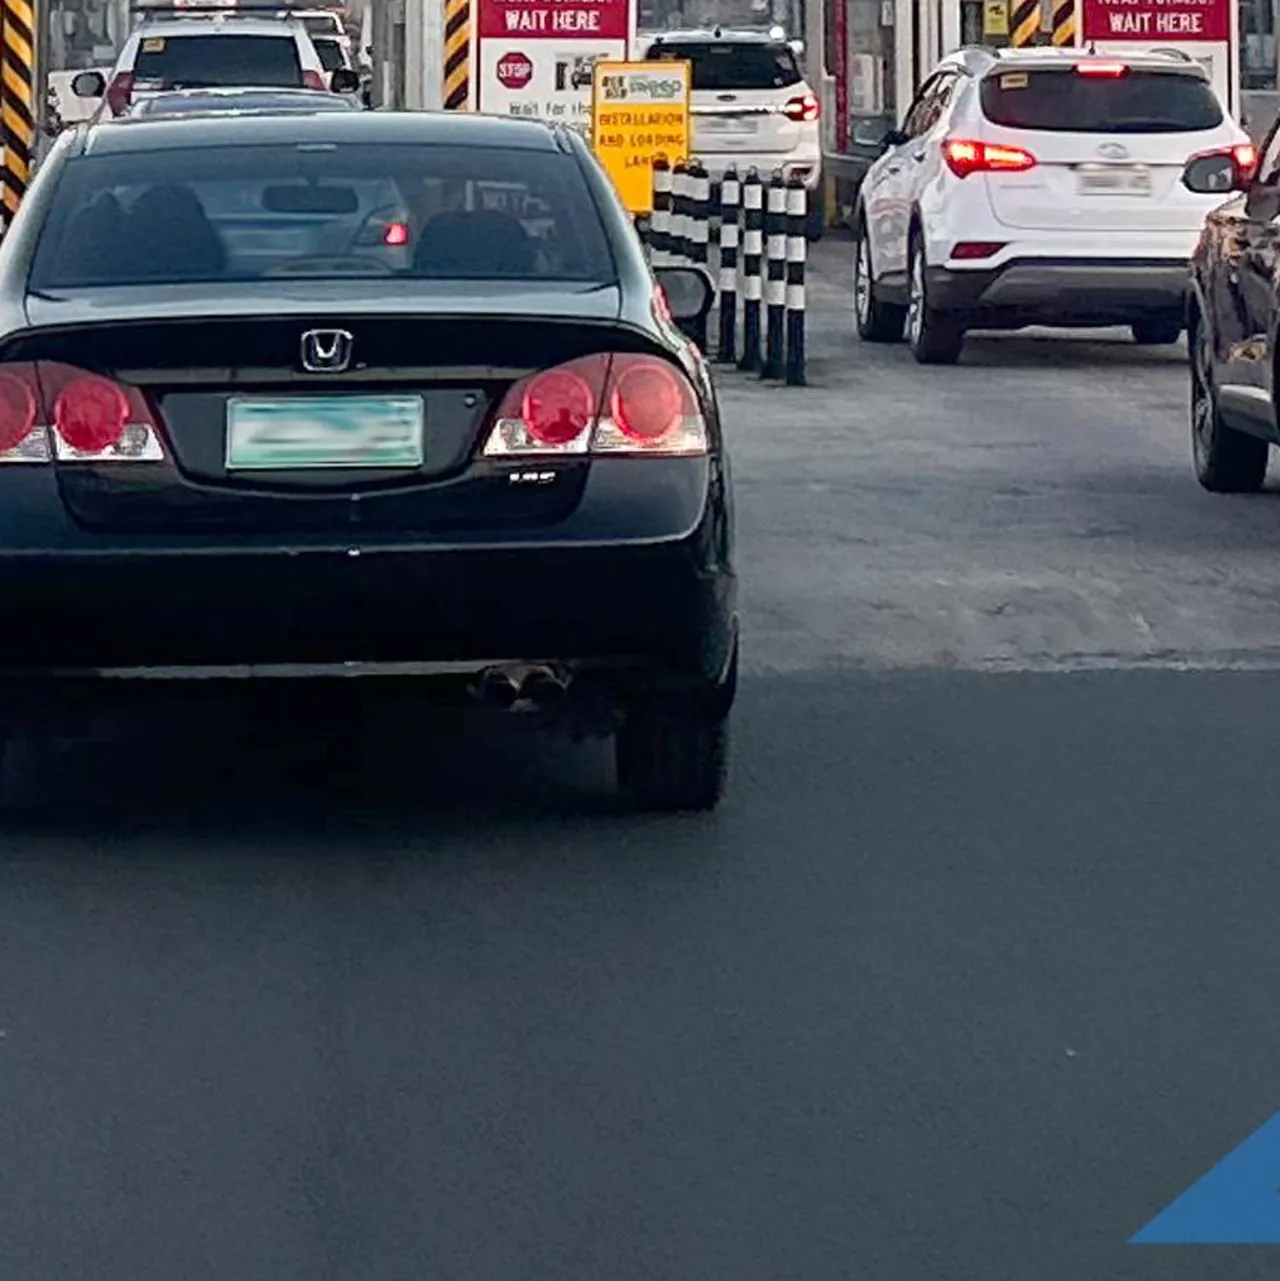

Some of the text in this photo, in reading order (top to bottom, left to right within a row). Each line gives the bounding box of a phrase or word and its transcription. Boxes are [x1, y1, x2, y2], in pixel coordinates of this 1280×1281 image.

[504, 9, 601, 31] WAIT HERE
[1108, 11, 1204, 33] WAIT HERE
[499, 62, 531, 79] STOP
[546, 101, 566, 115] for
[600, 134, 624, 147] AND
